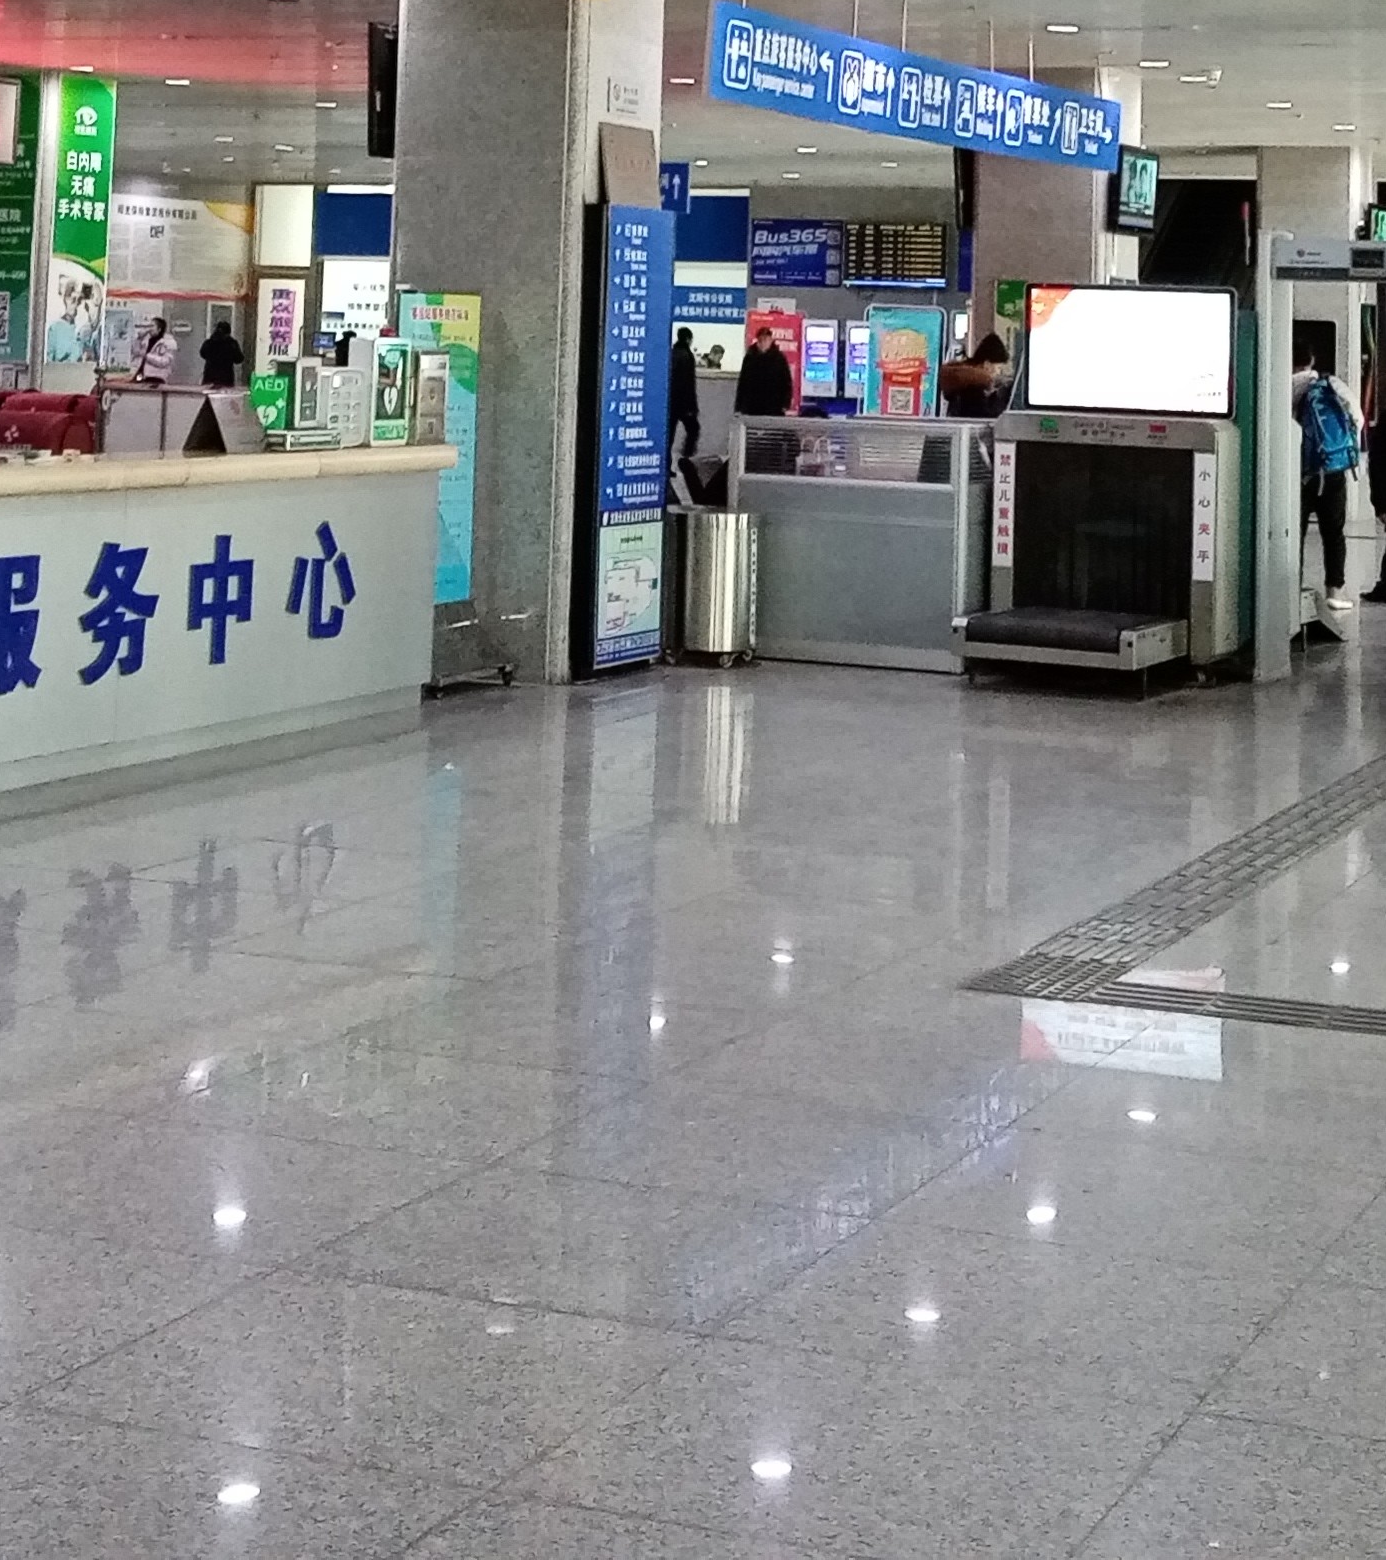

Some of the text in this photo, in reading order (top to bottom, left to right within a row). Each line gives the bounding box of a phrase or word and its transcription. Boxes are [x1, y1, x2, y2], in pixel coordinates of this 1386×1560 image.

[1079, 108, 1104, 136] 卫生间
[66, 150, 103, 173] 白内障
[70, 175, 96, 198] 无痛
[57, 199, 106, 222] 手术专家
[754, 228, 828, 244] Bus365
[254, 378, 285, 391] AED
[997, 453, 1011, 556] 禁止儿童触摸
[1196, 469, 1212, 564] 小心夹手
